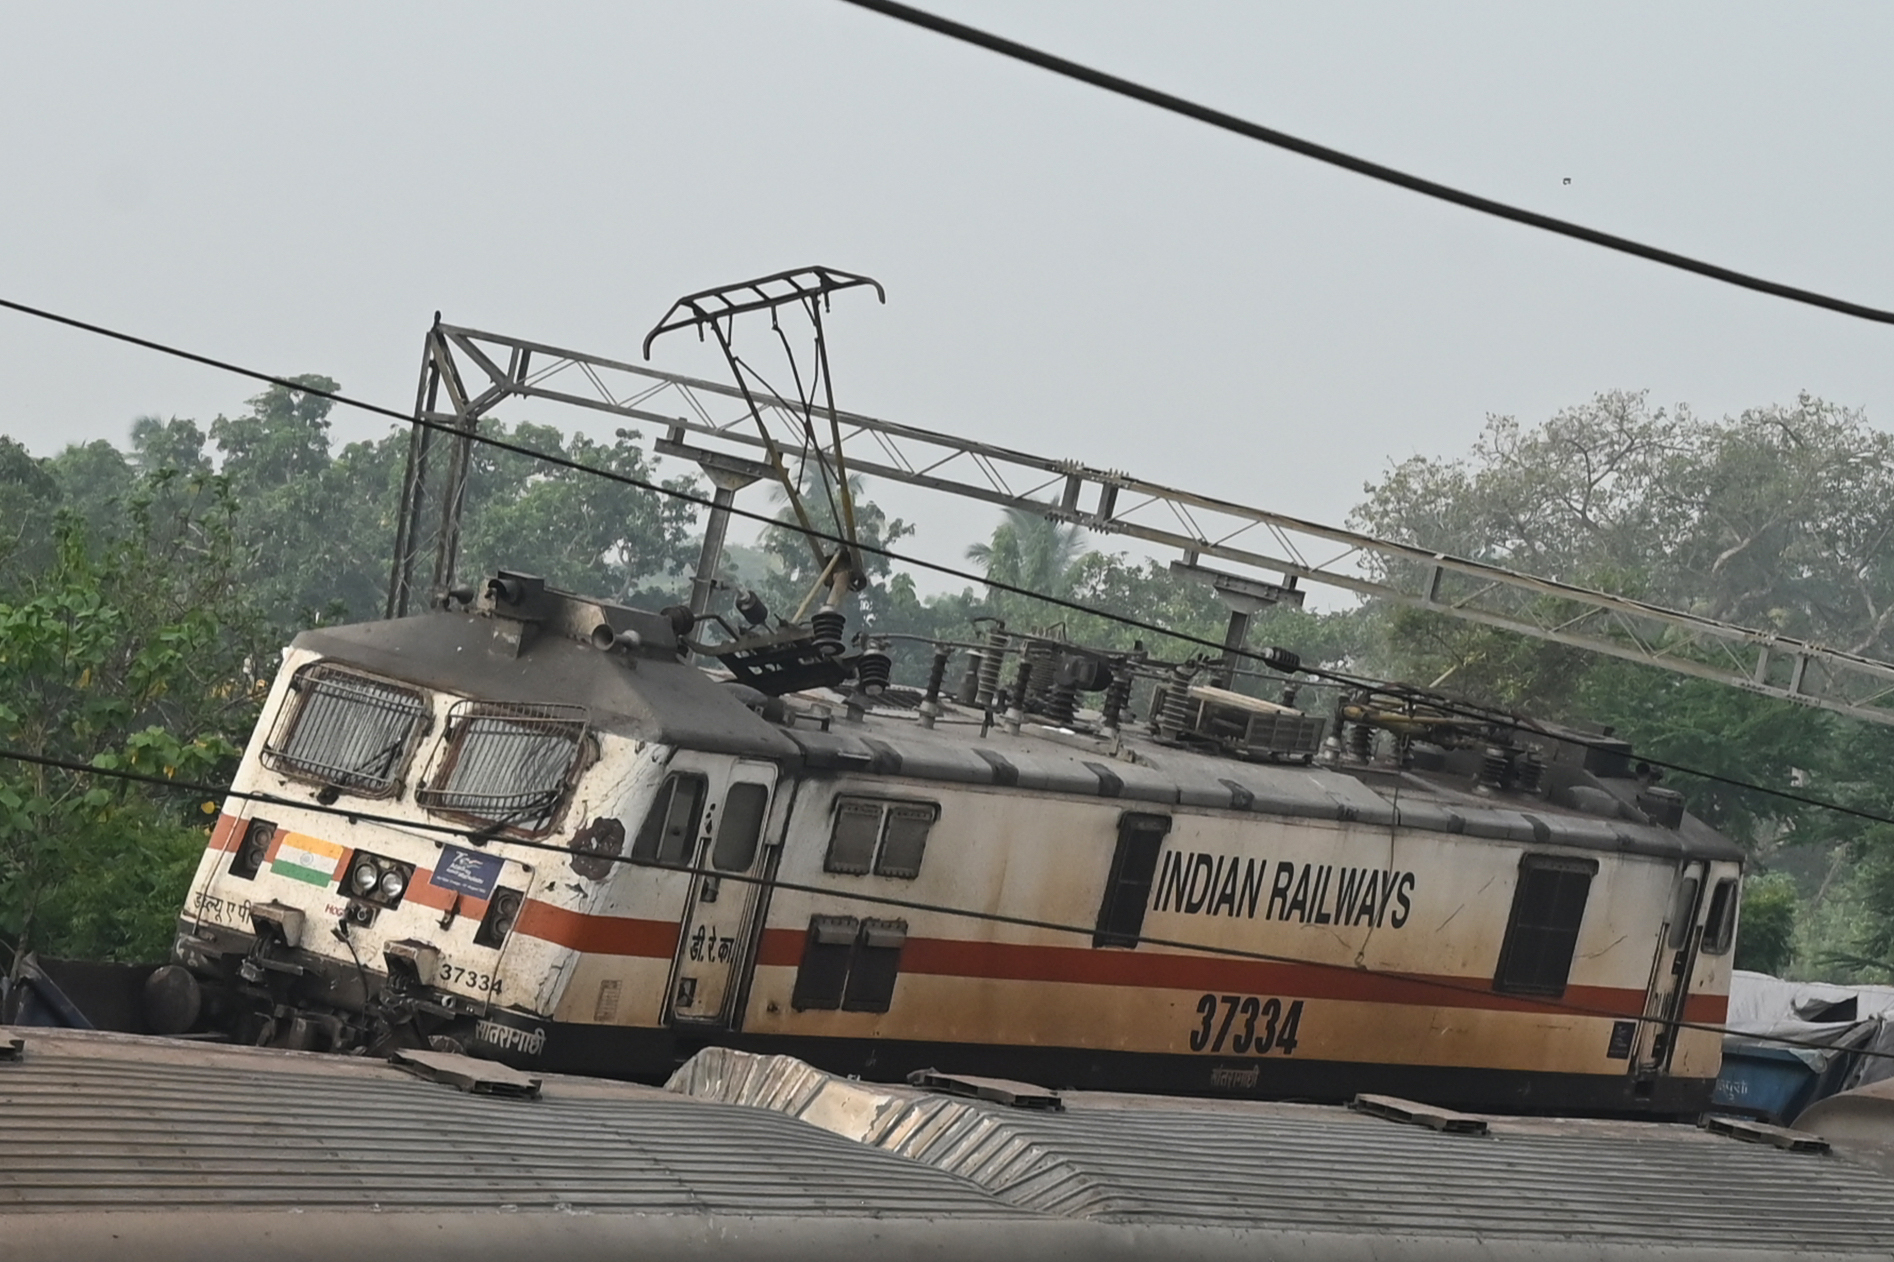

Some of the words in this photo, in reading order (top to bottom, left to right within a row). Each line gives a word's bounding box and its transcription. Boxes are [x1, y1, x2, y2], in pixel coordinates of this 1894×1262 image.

[1153, 850, 1267, 919] INDIAN
[1266, 861, 1415, 929] RAILWAYS
[440, 963, 503, 996] 37334
[1189, 993, 1304, 1055] 37334
